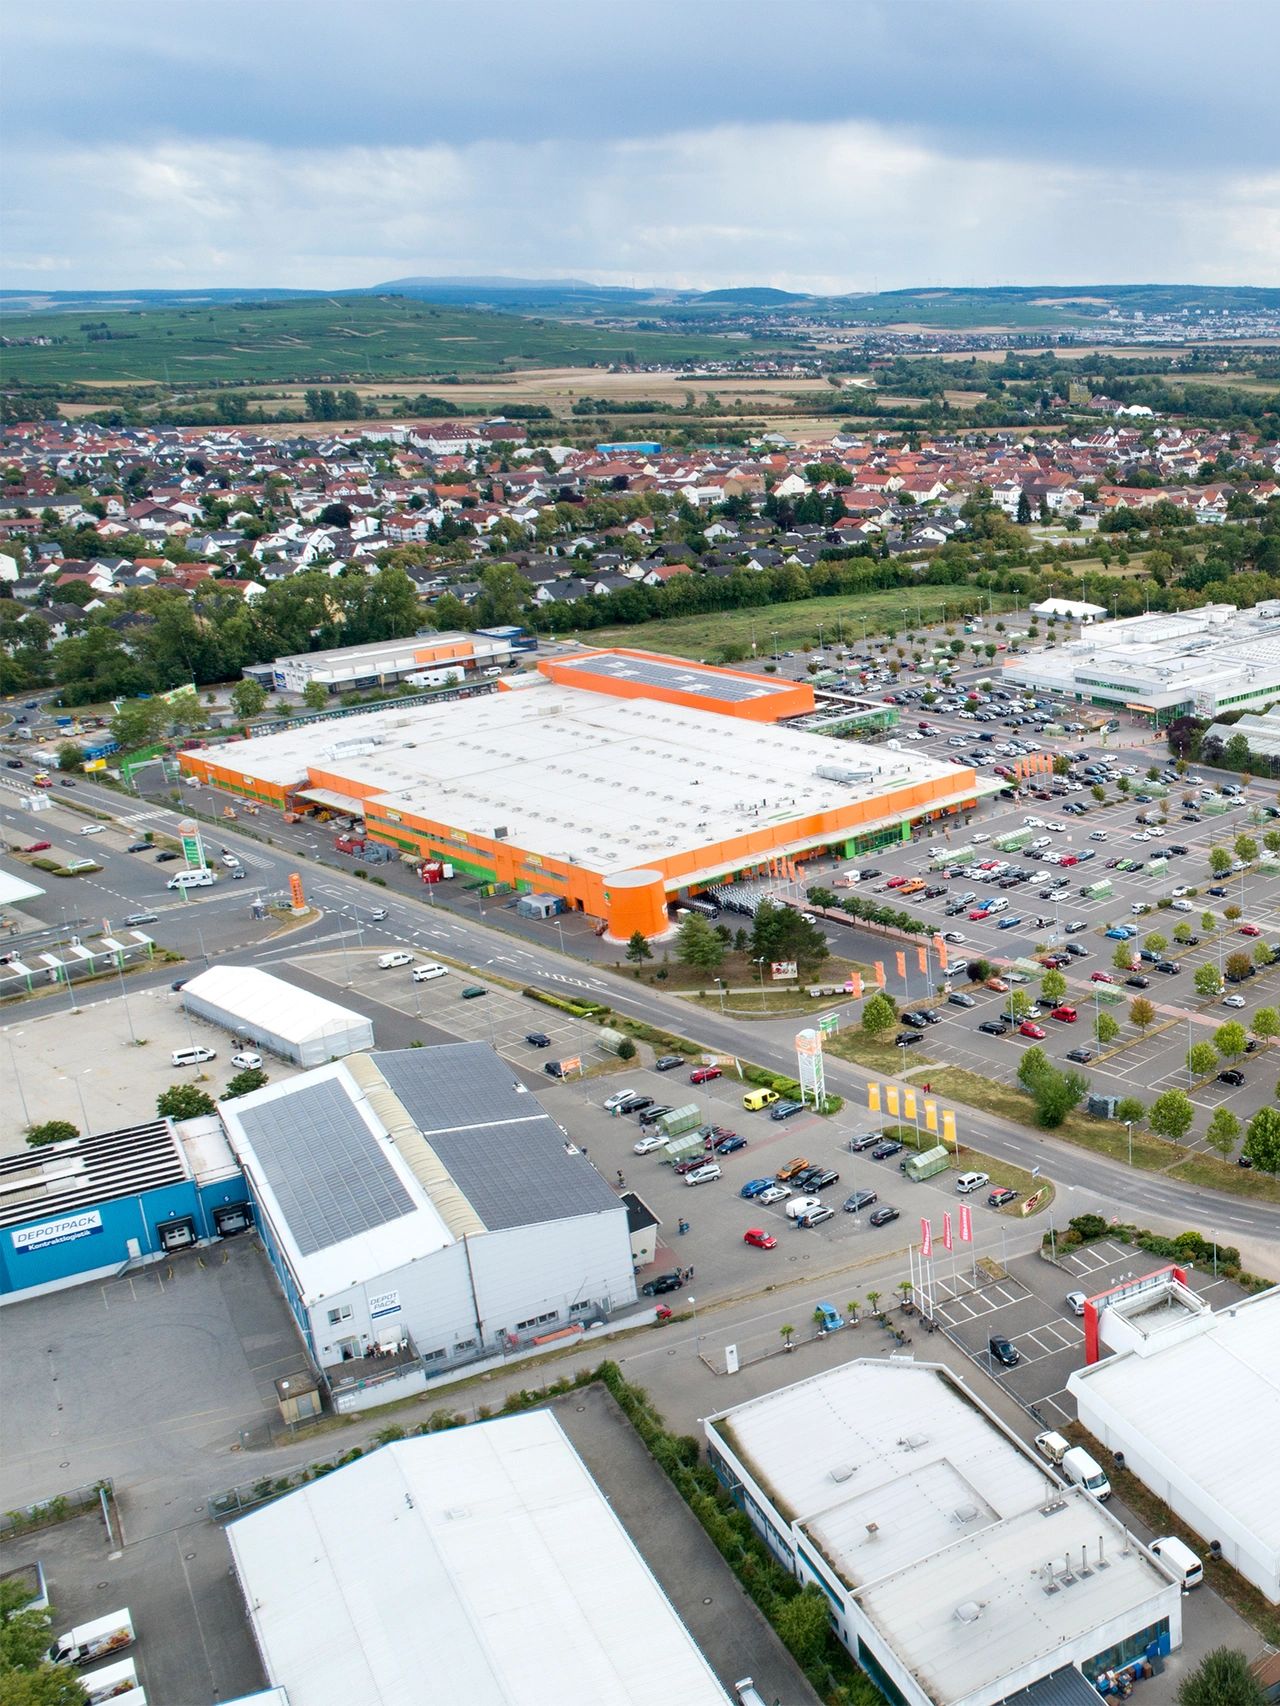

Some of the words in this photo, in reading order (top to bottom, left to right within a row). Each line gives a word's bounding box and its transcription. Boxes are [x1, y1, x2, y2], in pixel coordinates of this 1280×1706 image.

[17, 1215, 96, 1243] DEPOTPACK
[28, 1229, 91, 1251] Kontraktlogistik
[370, 1292, 397, 1305] DEPOT
[374, 1299, 397, 1310] PACK
